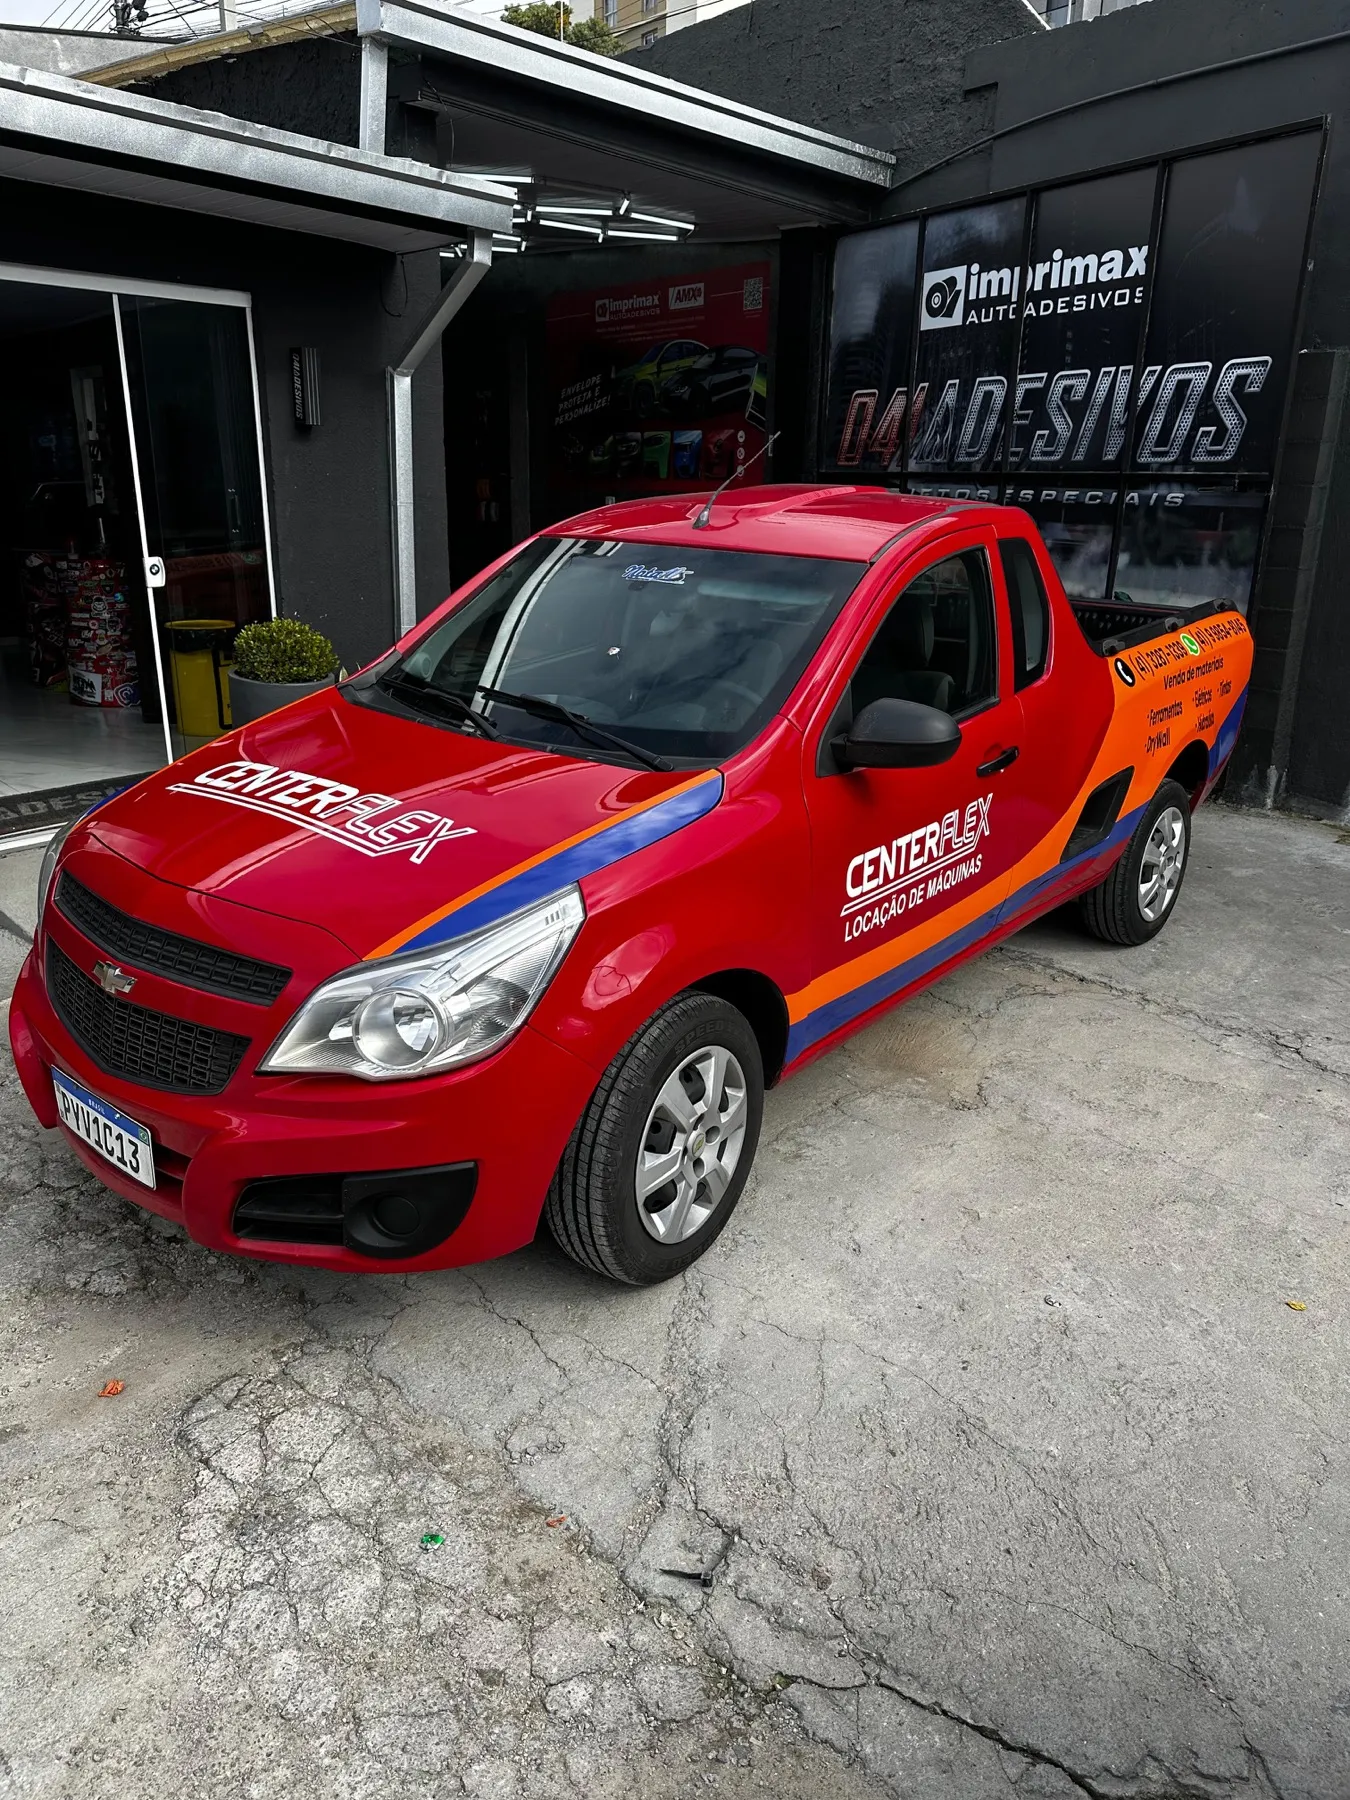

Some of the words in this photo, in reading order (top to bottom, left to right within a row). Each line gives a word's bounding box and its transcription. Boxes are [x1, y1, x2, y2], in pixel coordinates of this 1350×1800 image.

[609, 293, 660, 313] imprimax
[558, 390, 592, 413] PROTEJA
[595, 386, 601, 397] E
[560, 374, 602, 399] ENVELOPE
[1004, 489, 1185, 507] ESPECIAIS
[1163, 669, 1185, 690] Venda
[1187, 666, 1195, 681] de
[1196, 655, 1224, 678] materiais
[194, 760, 478, 865] CENTERFLEX
[846, 793, 993, 898] CENTERFLEX
[844, 893, 907, 943] LOCAÇÃO
[908, 883, 925, 910] DE
[926, 854, 983, 900] MÁQUINAS
[61, 1090, 140, 1174] PYV1C13
